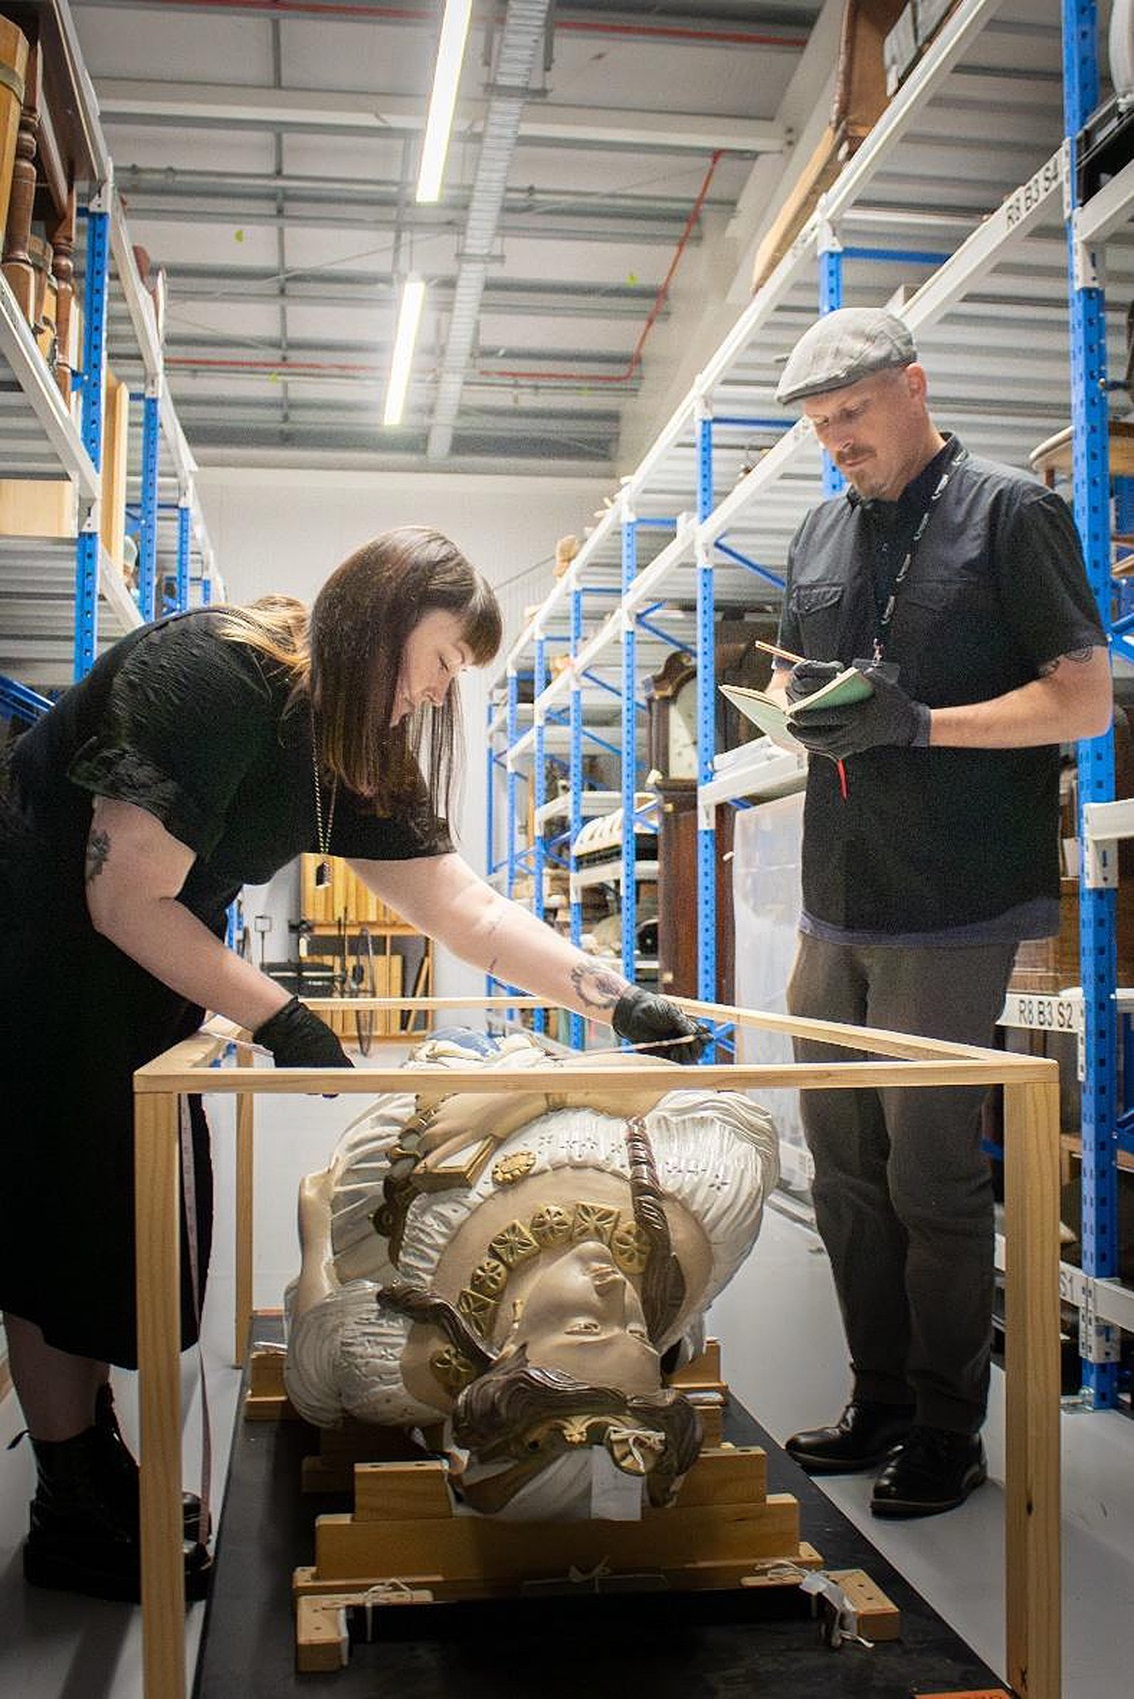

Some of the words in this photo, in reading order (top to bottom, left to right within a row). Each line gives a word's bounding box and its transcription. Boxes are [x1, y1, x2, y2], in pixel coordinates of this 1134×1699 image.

[1025, 178, 1040, 213] B3
[1044, 158, 1059, 192] S4
[1019, 1000, 1033, 1025] R8
[1038, 1001, 1053, 1027] B3
[1057, 1002, 1073, 1028] S2
